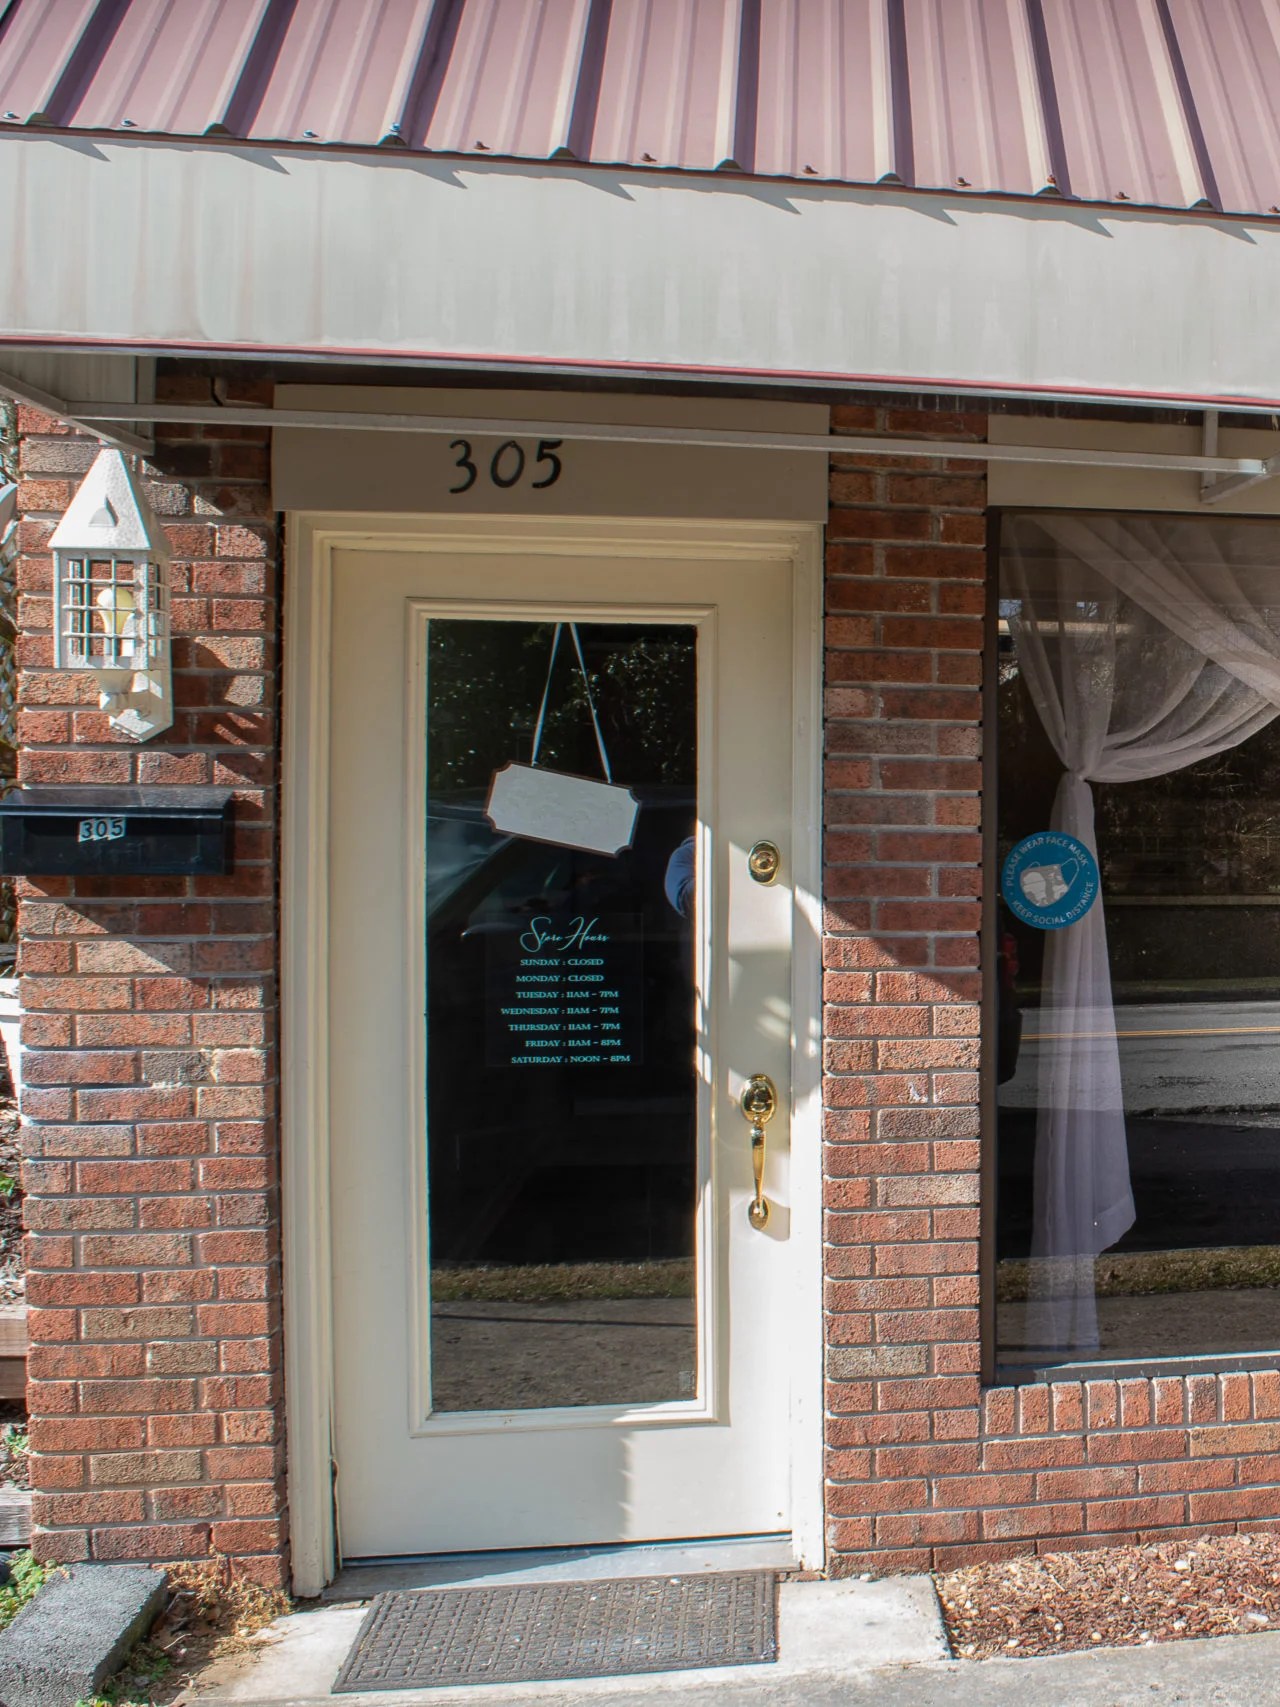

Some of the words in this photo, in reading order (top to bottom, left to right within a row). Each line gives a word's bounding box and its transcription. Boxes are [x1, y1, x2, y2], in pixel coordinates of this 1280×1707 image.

[448, 439, 564, 494] 305
[81, 819, 124, 839] 305
[1006, 852, 1021, 886] PLEASE
[1019, 837, 1045, 854] WEAR
[1046, 836, 1067, 847] FACE
[1068, 843, 1089, 866] MASK
[1012, 900, 1032, 918] KEEP
[1032, 914, 1066, 925] SOCIAL
[1066, 882, 1094, 919] DISTANCE
[520, 916, 562, 952] Store
[557, 916, 610, 950] Hours
[568, 958, 604, 966] CLOSED
